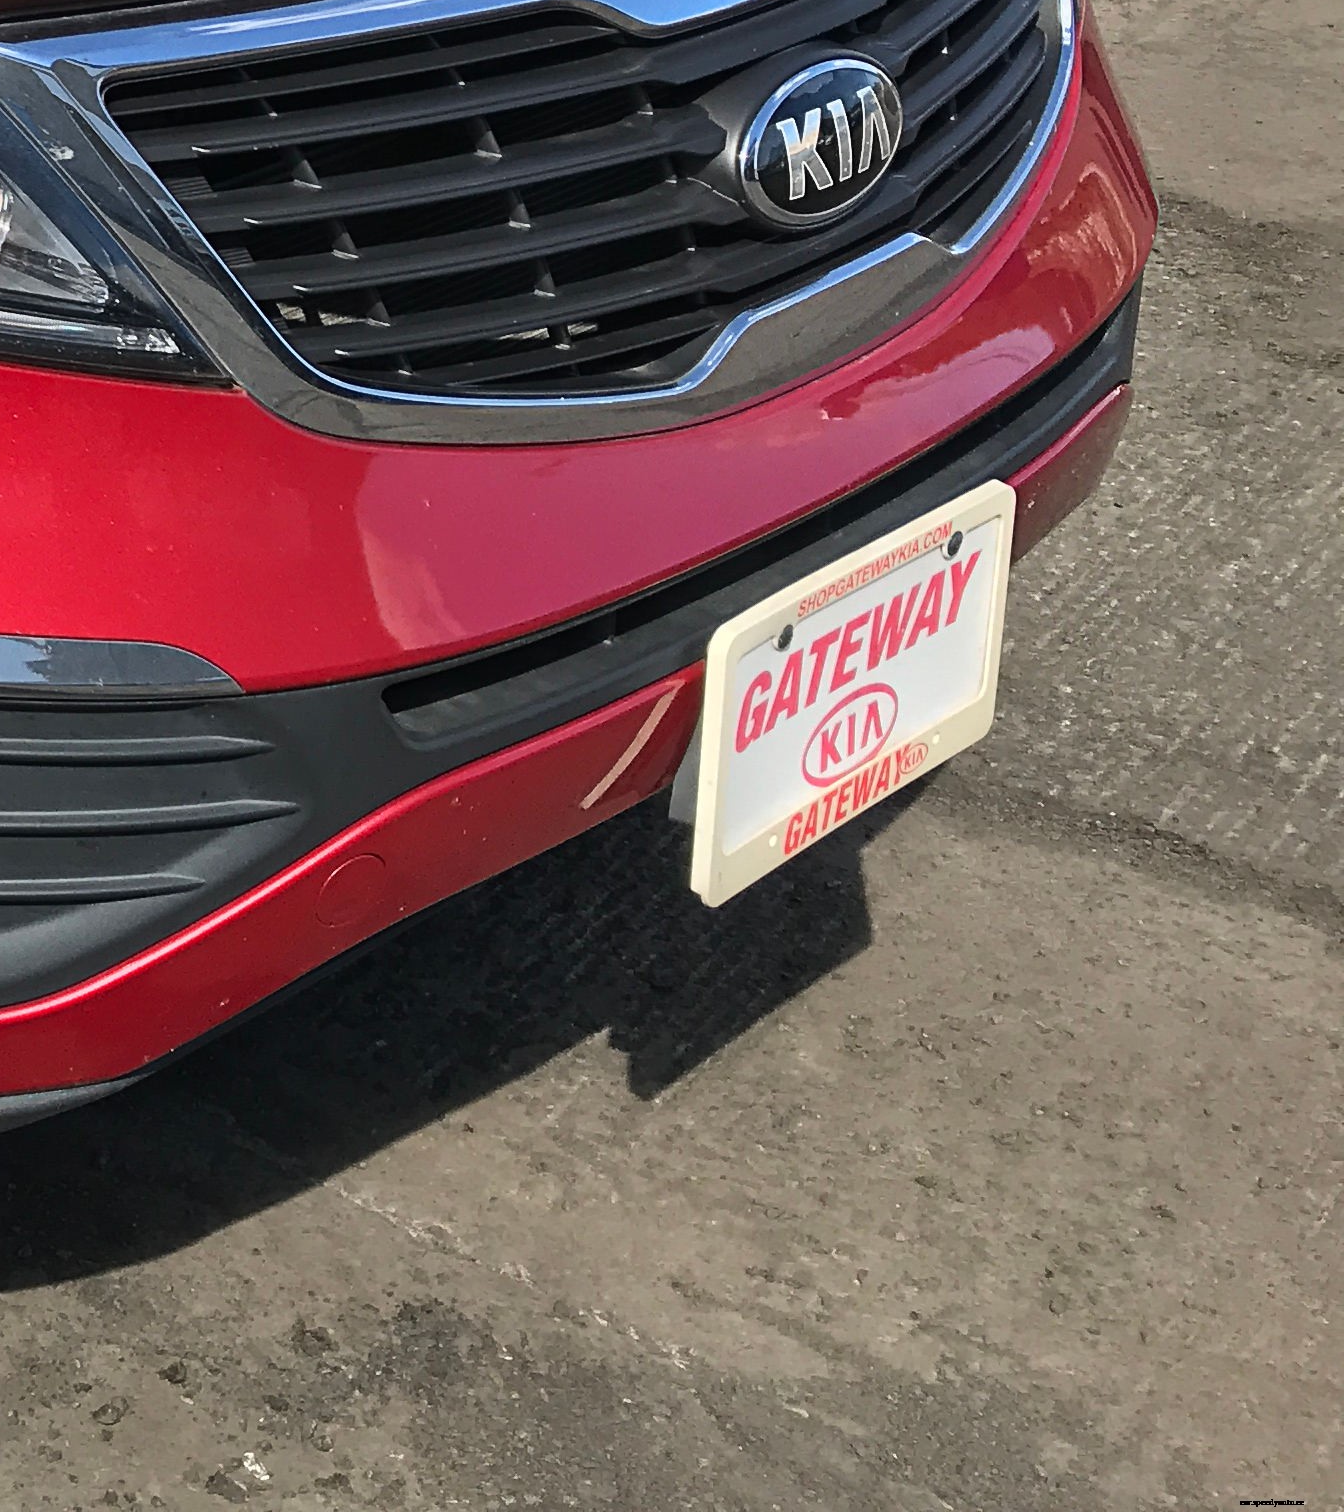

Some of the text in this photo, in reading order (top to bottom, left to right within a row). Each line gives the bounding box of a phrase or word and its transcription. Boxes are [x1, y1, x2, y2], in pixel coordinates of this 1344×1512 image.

[776, 85, 891, 200] KIA
[797, 521, 953, 618] SHOPGATEWAYKIA.COM
[734, 550, 982, 753] GATEWAY
[820, 699, 883, 774] KIA
[784, 743, 912, 855] GATEWAY
